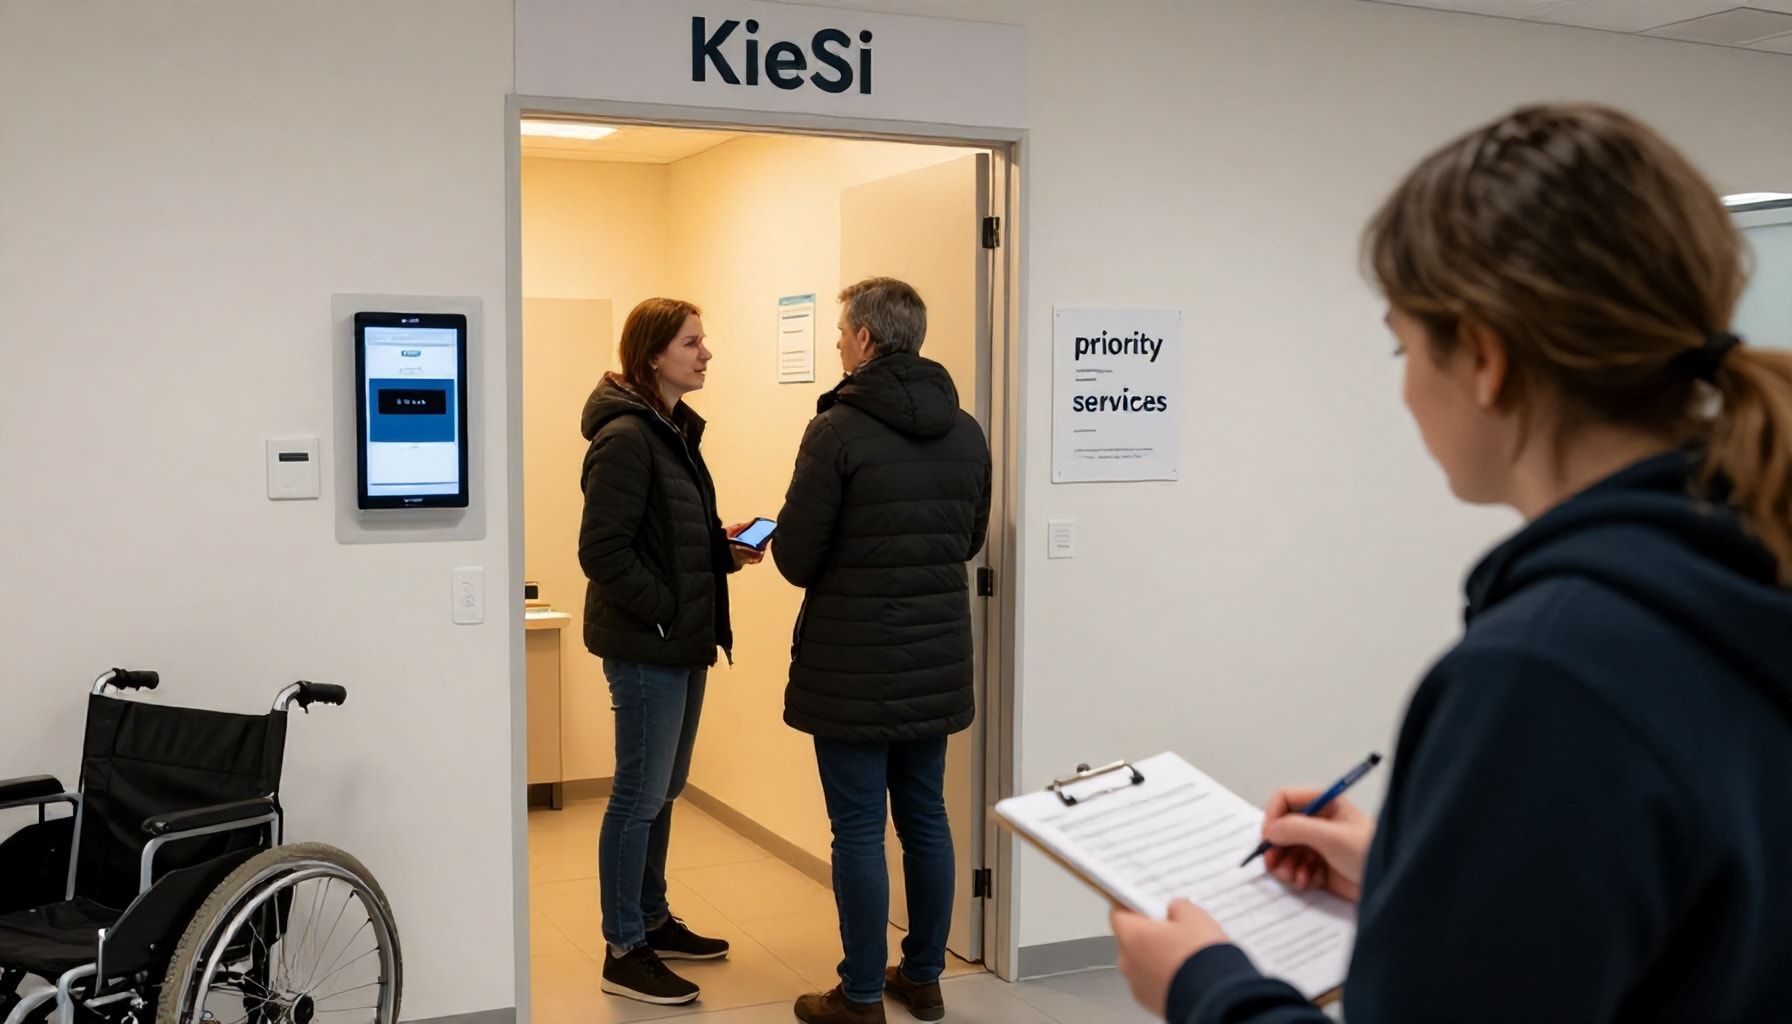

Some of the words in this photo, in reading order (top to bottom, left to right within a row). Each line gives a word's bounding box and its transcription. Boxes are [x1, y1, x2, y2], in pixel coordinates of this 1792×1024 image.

[692, 16, 872, 94] KieSi
[1075, 330, 1163, 362] priority
[1073, 388, 1167, 412] services
